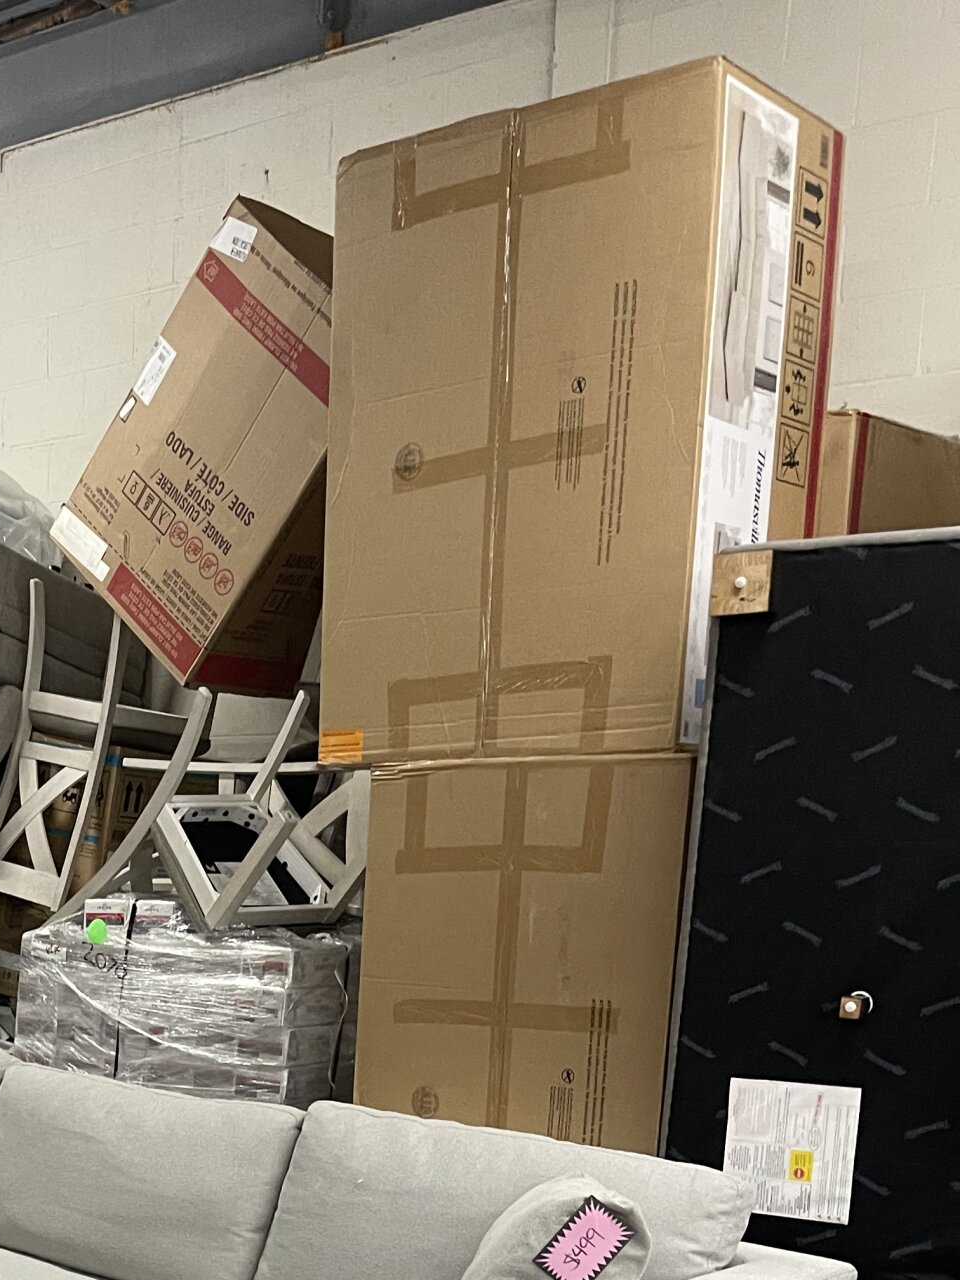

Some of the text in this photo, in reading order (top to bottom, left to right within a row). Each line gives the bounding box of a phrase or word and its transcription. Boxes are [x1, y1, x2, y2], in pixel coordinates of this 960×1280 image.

[166, 431, 194, 465] LADO
[156, 472, 200, 522] CUISINIÈRE
[184, 479, 215, 516] ESTUFA
[195, 463, 224, 496] CÔTÉ
[228, 495, 254, 526] SIDE
[202, 520, 232, 556] RANGE
[563, 1228, 605, 1270] $499
